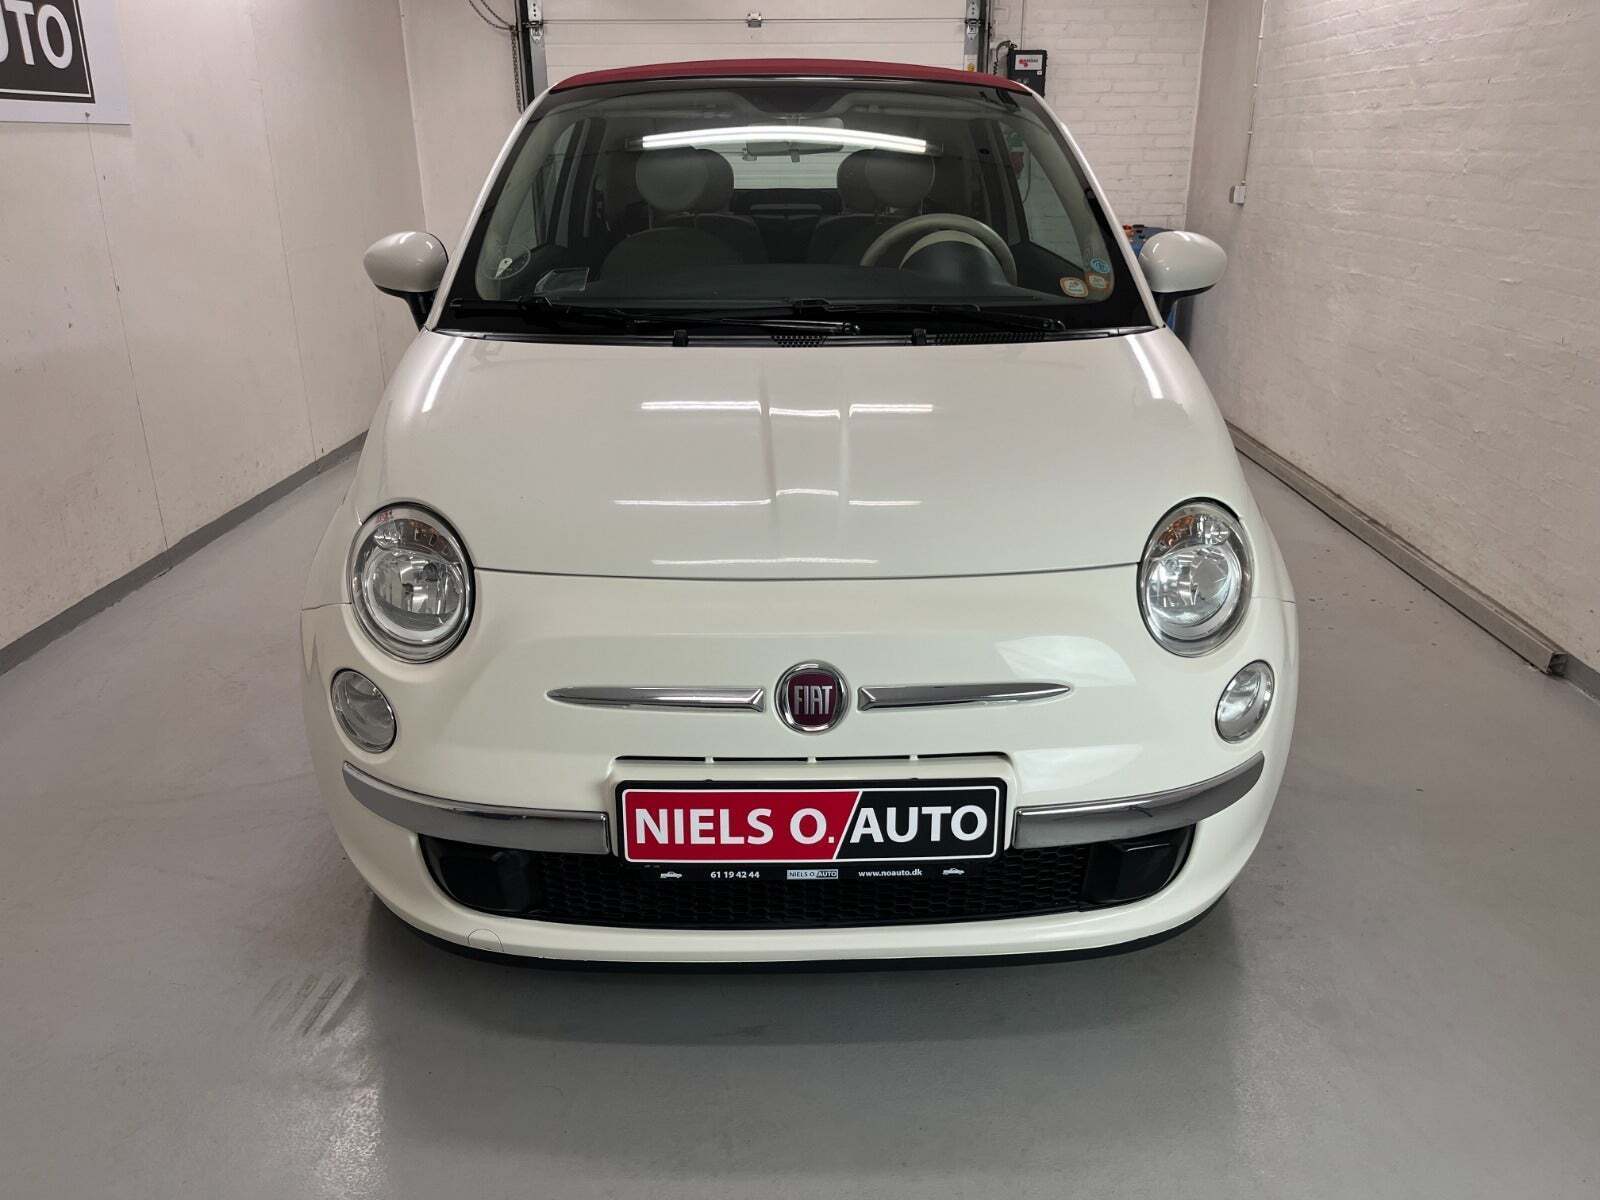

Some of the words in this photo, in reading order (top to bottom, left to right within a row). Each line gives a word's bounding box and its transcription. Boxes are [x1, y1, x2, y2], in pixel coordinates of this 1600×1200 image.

[0, 0, 73, 69] TO
[793, 685, 833, 715] FIAT
[635, 808, 774, 845] NIELS
[790, 807, 835, 845] O.
[849, 804, 988, 844] AUTO
[710, 871, 721, 879] 61
[723, 871, 735, 879] 19
[735, 871, 747, 879] 42
[748, 871, 761, 879] 44
[816, 870, 838, 878] AUTO
[858, 868, 922, 877] www.noauto.dk
